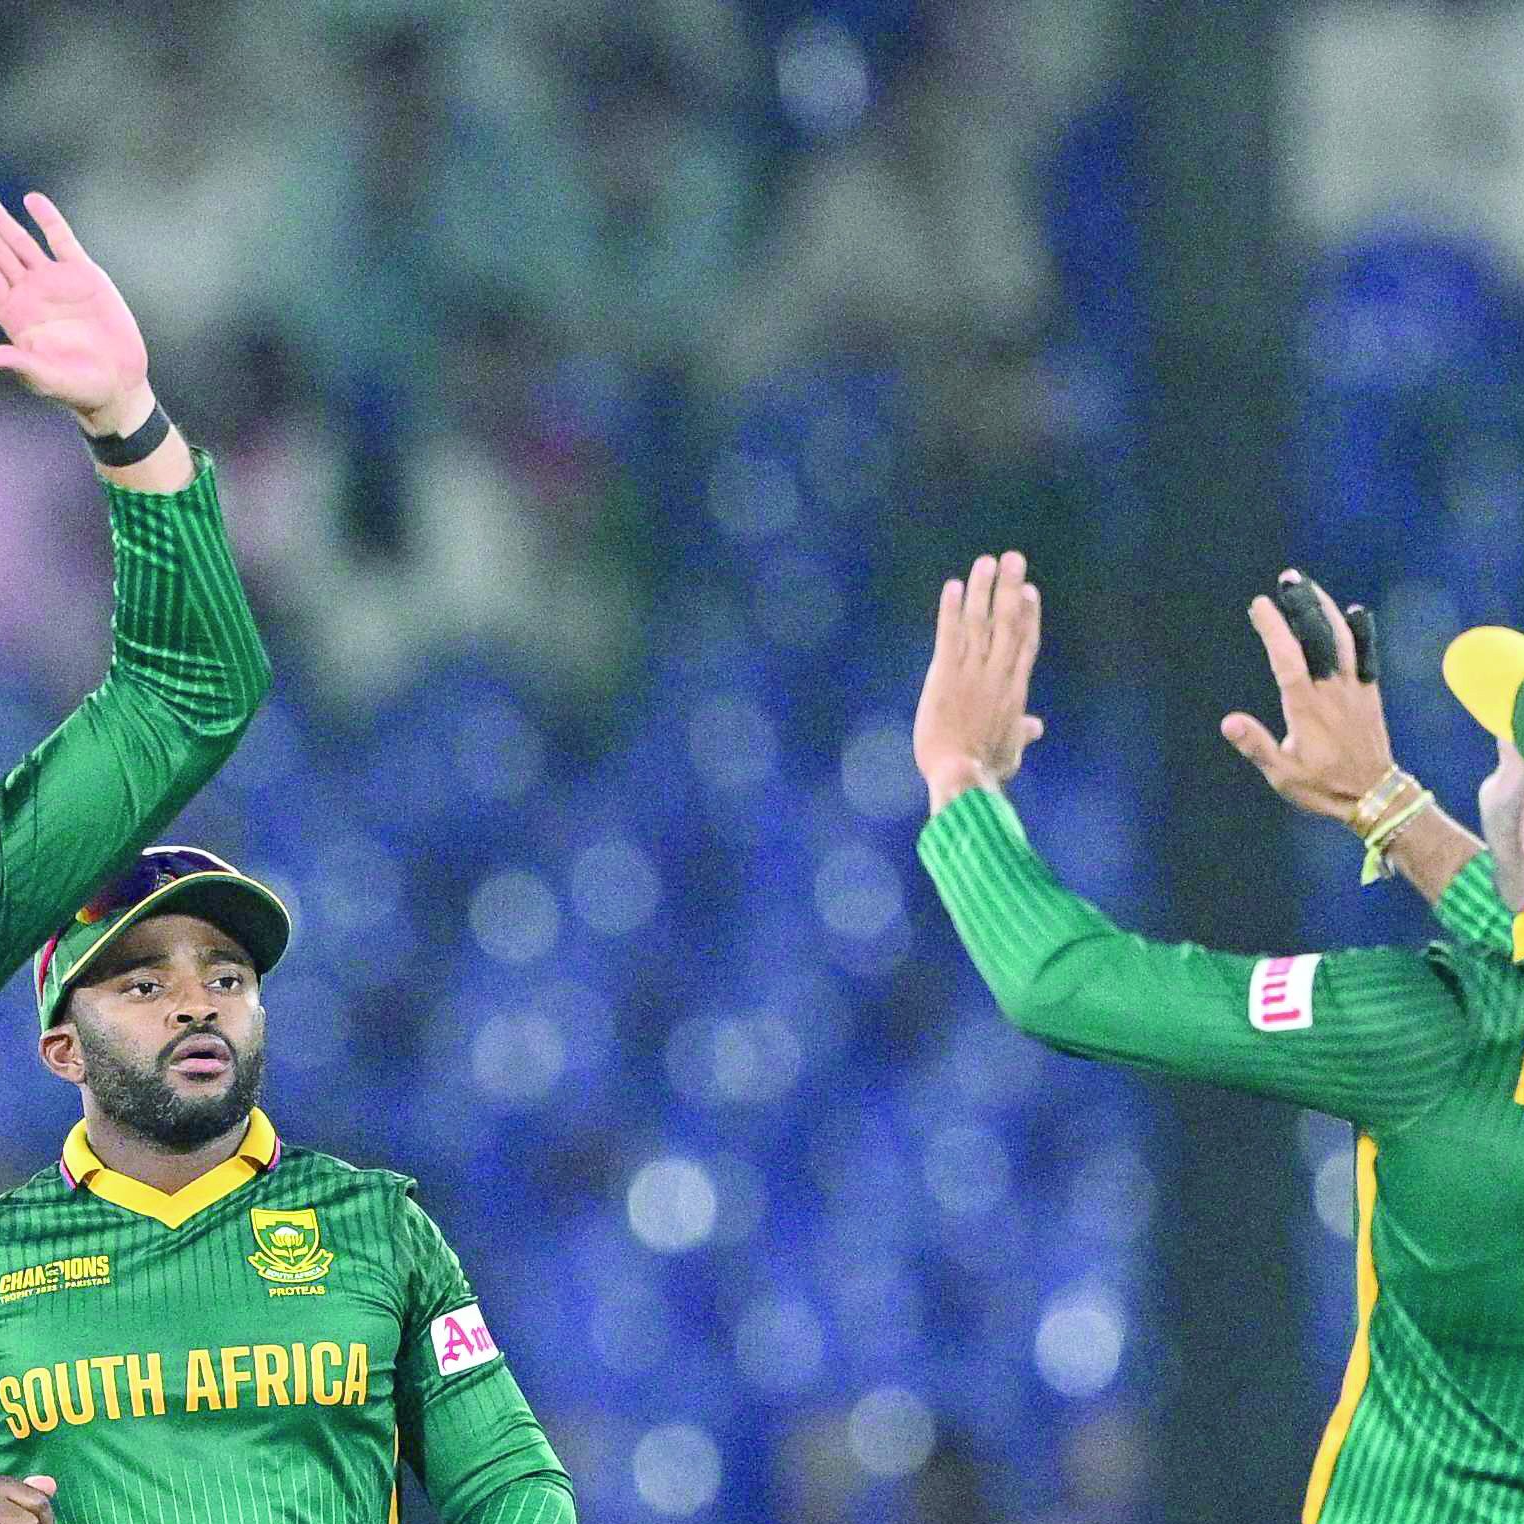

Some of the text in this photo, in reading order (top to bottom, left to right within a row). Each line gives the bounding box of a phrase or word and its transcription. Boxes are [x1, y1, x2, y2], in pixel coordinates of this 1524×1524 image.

[268, 1285, 326, 1297] PROTEAS
[441, 1316, 494, 1371] Am
[185, 1341, 369, 1412] AFRICA
